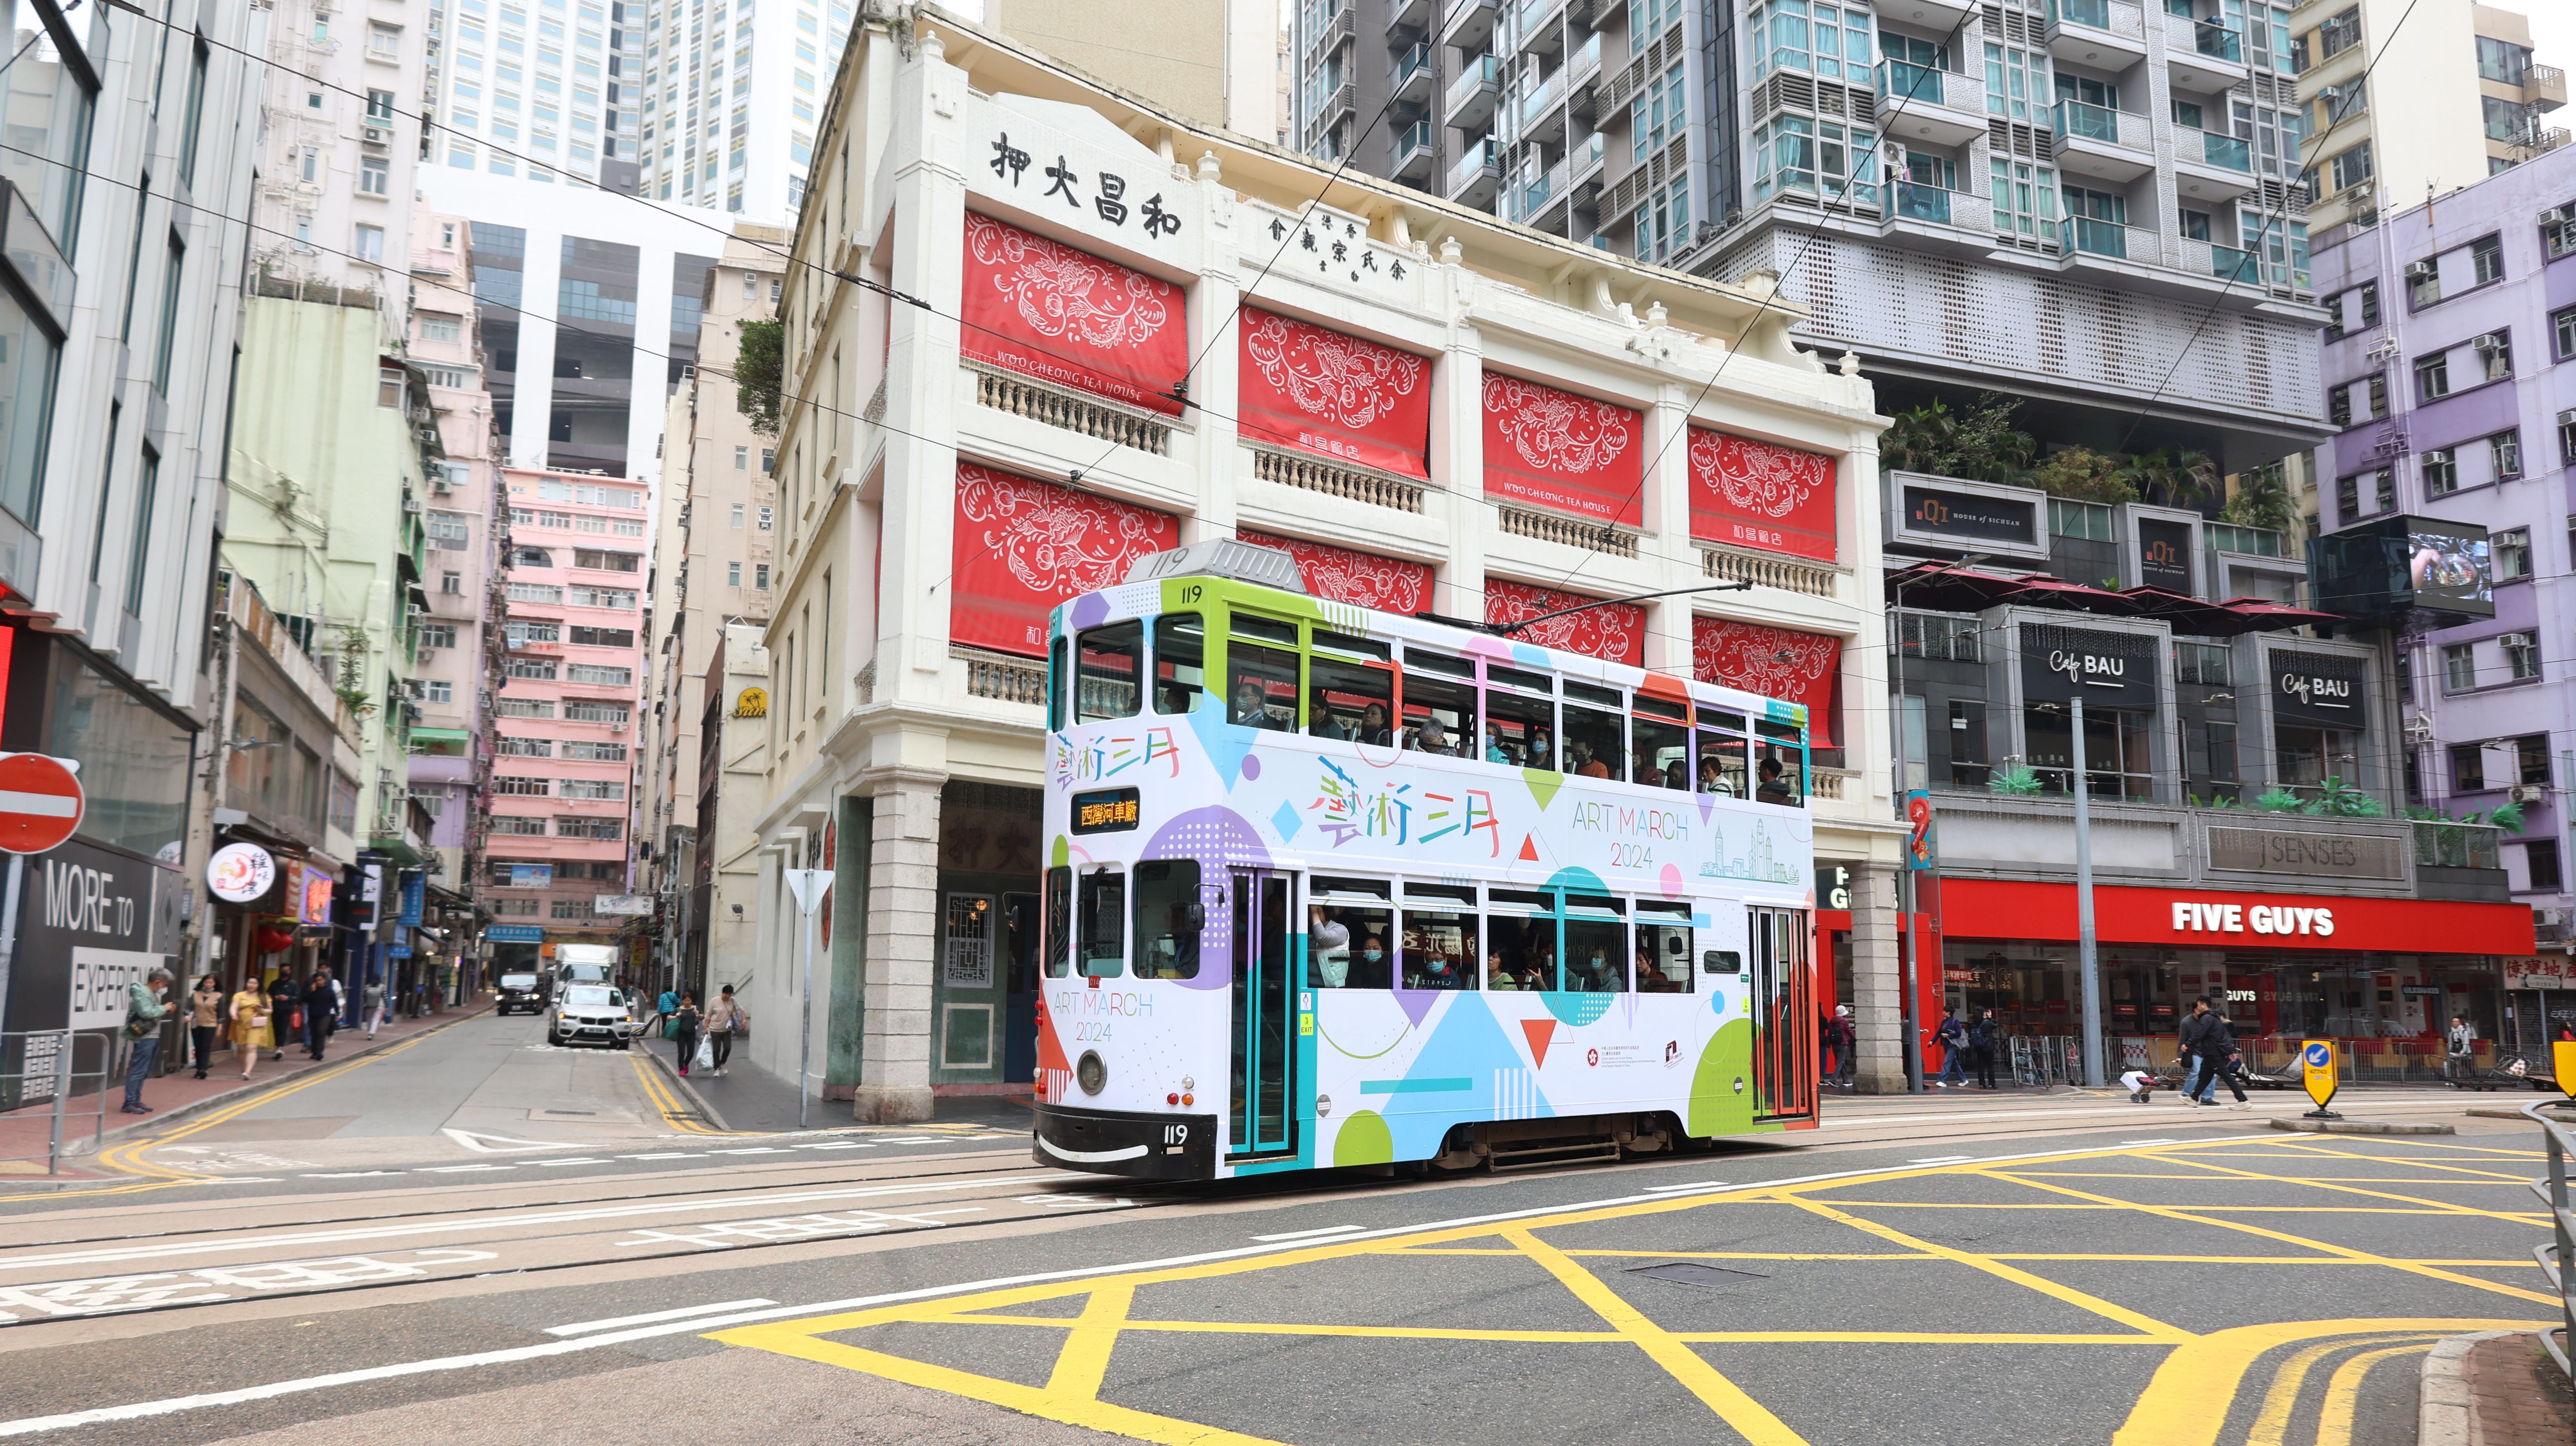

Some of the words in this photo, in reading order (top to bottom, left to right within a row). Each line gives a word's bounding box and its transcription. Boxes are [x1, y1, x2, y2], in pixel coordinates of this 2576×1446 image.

[998, 350, 1027, 369] WOO
[1030, 361, 1079, 384] CHEONG
[1083, 376, 1103, 390] TEA
[1106, 383, 1143, 401] HOUSE
[1299, 432, 1360, 460] 和昌飯店
[1504, 482, 1526, 494] WOO
[1528, 487, 1564, 505] CHEONG
[1566, 497, 1582, 508] TEA
[1583, 500, 1611, 514] HOUSE
[1953, 512, 1977, 521] HOUSE
[1979, 514, 1987, 523] of
[1988, 517, 2021, 527] SICHUAN
[1733, 524, 1782, 546] 和昌飯店
[1148, 547, 1190, 578] 119
[1182, 585, 1202, 604] 119
[2085, 655, 2124, 676] BAU
[2313, 678, 2349, 697] BAU
[1054, 726, 1180, 793] 藝術三月
[1307, 755, 1499, 858] 藝術三月
[1572, 801, 1614, 833] ART
[1619, 806, 1688, 842] MARCH
[1611, 843, 1653, 869] 2024
[2272, 836, 2356, 868] SENSES
[45, 859, 113, 934] MORE
[117, 896, 134, 938] TO
[2173, 902, 2244, 932] FIVE
[2249, 905, 2334, 937] GUYS
[75, 963, 155, 1012] EXPERI
[1089, 978, 1099, 987] 014
[2226, 990, 2256, 1002] GUYS
[1054, 992, 1080, 1015] ART
[1083, 992, 1153, 1016] MARCH
[1076, 1022, 1112, 1042] 2024
[1164, 1125, 1188, 1145] 119
